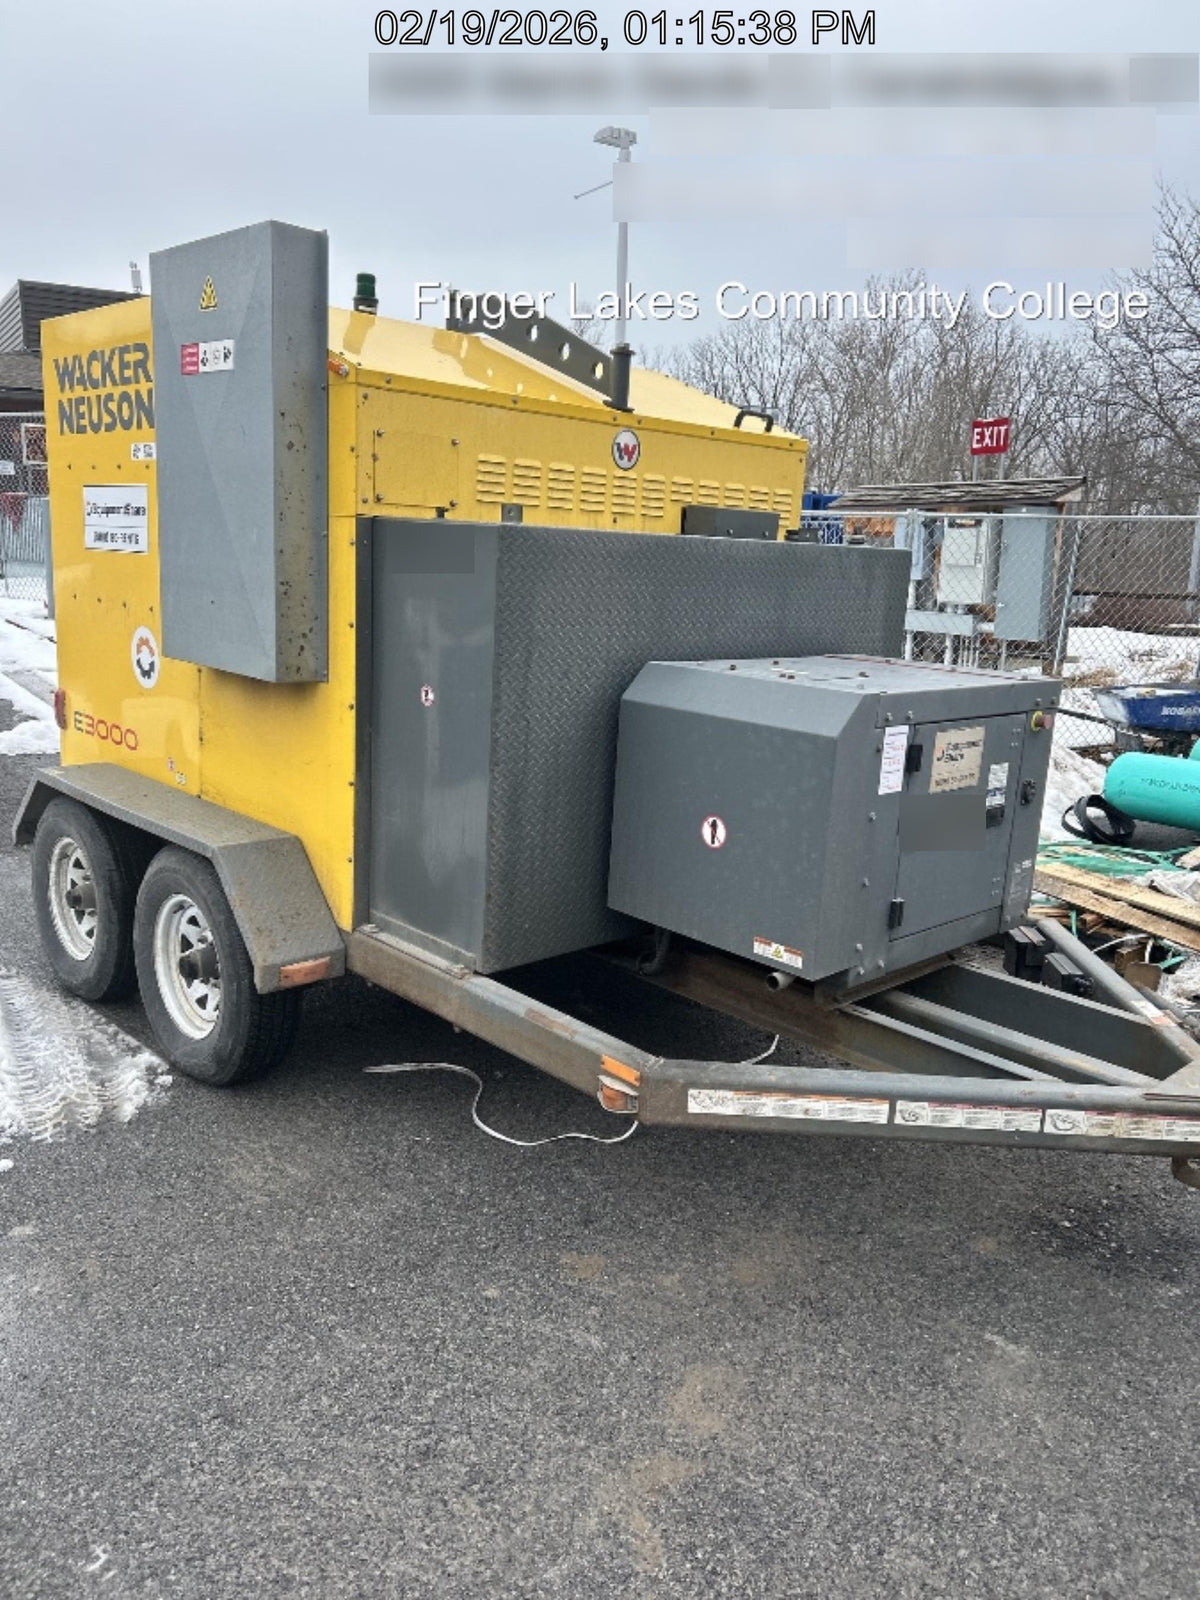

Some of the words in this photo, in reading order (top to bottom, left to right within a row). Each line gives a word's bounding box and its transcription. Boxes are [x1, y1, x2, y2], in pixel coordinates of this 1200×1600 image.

[53, 342, 153, 393] WACKER
[58, 387, 155, 436] NEUSON
[972, 425, 1008, 449] EXIT
[74, 711, 139, 751] E3000
